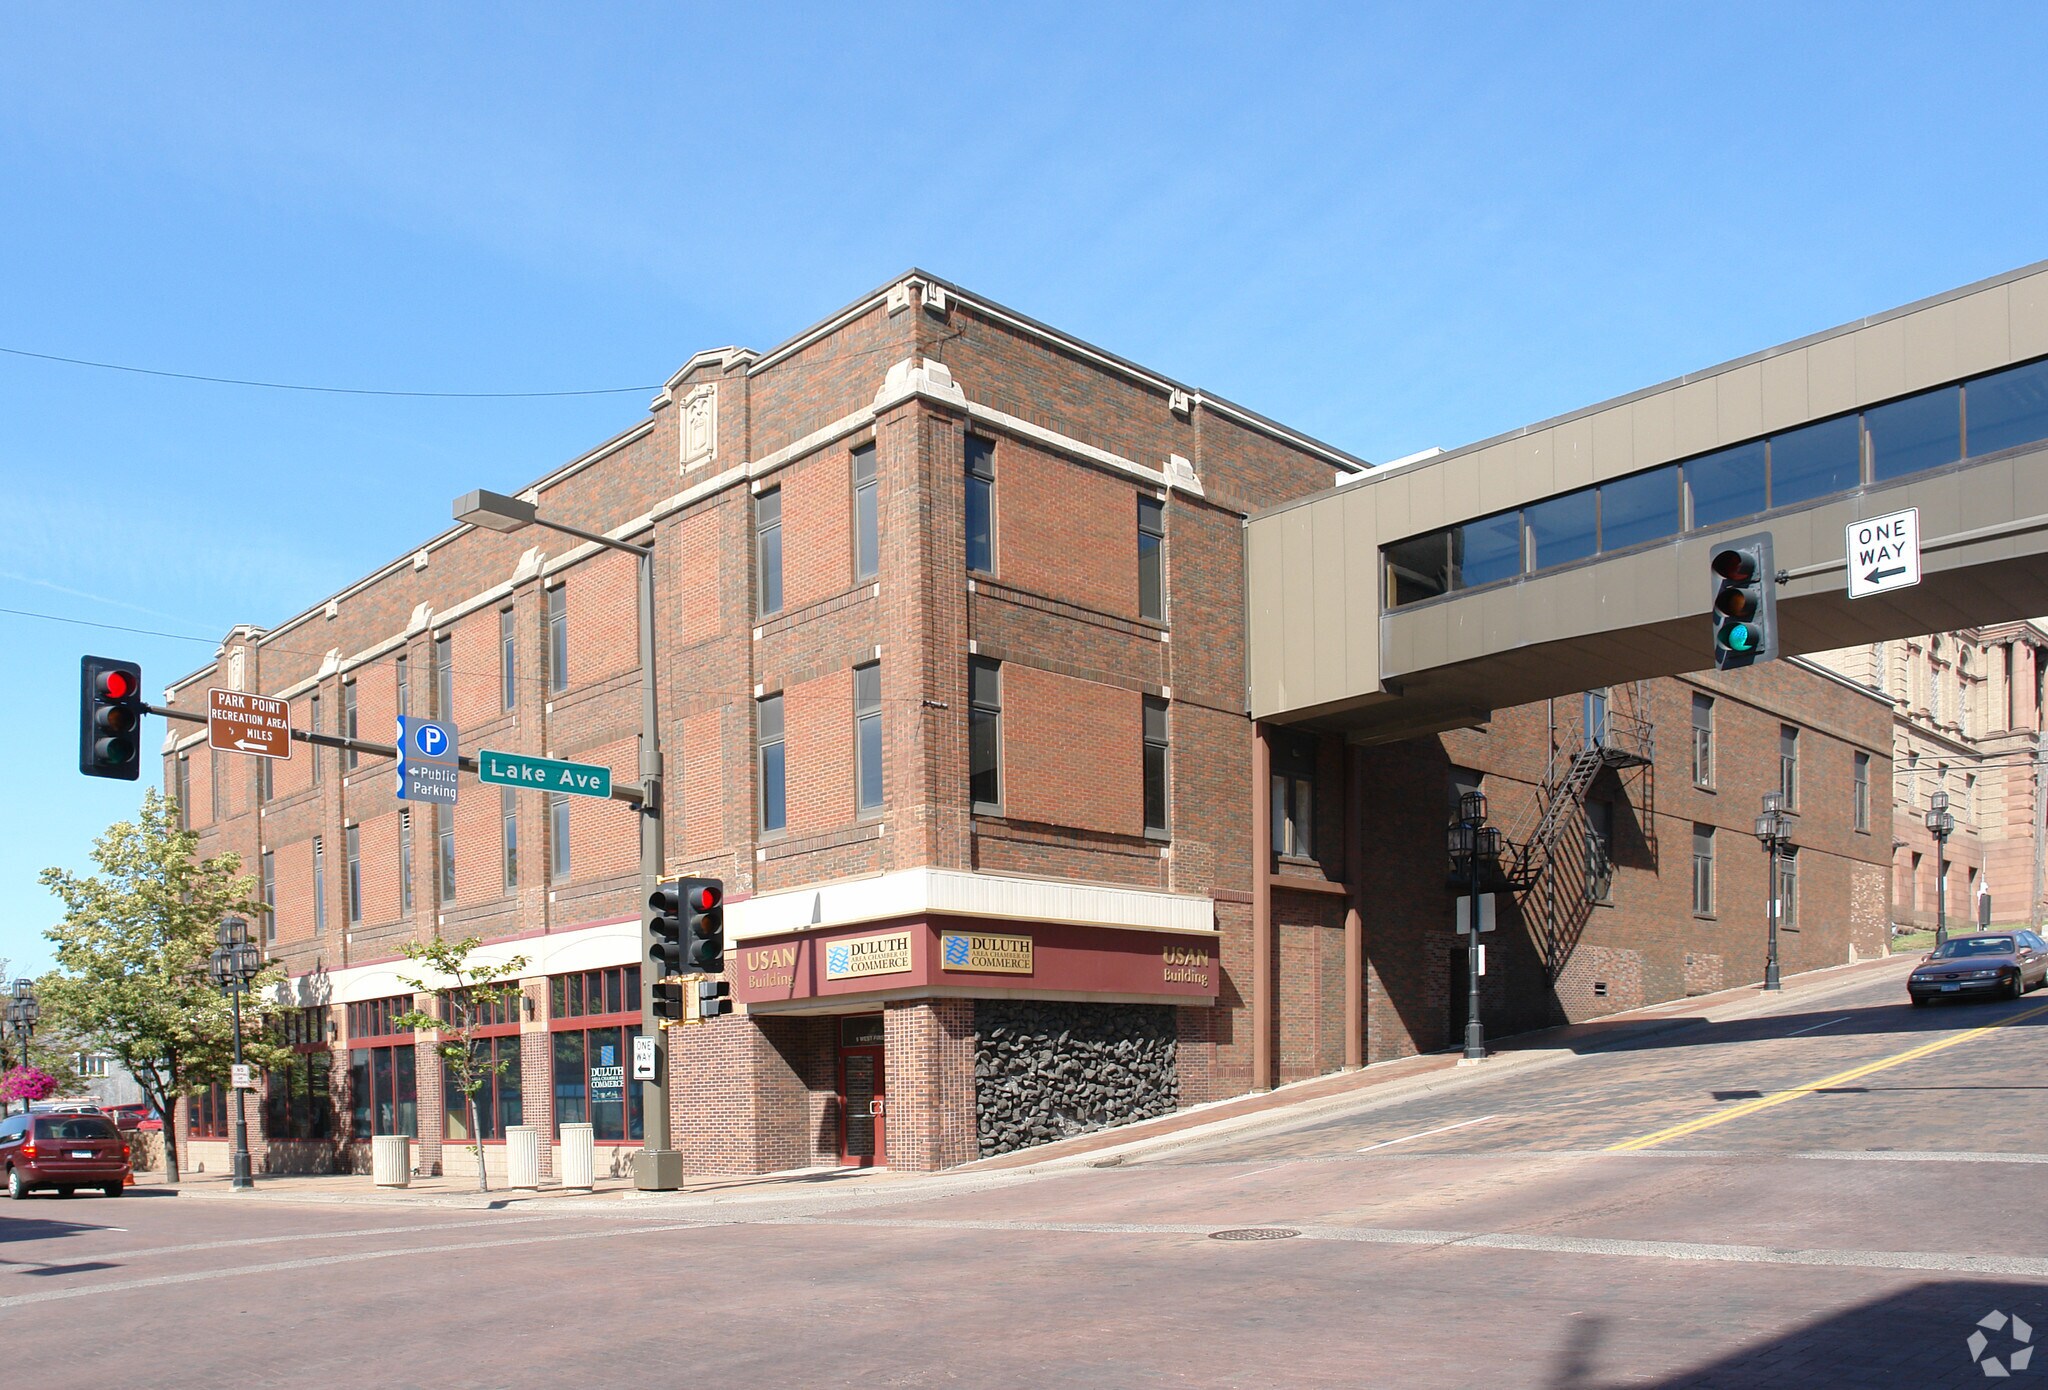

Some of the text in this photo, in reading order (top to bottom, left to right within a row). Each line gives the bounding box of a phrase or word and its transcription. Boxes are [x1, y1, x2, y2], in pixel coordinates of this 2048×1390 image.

[1859, 520, 1906, 545] ONE
[1859, 541, 1906, 566] WAY
[218, 693, 281, 714] PARK POINT
[211, 708, 288, 730] RECREATION AREA
[247, 728, 273, 741] MILES
[426, 727, 441, 753] P
[421, 767, 457, 782] Public
[491, 759, 601, 789] Lake Ave
[413, 781, 457, 802] Parking
[851, 937, 908, 956] DULUTH
[971, 937, 1031, 953] DULUTH
[746, 947, 796, 971] USAN
[851, 954, 867, 962] AREA
[867, 951, 898, 960] CHAMBER
[971, 957, 1031, 969] COMMERCE
[990, 951, 1021, 959] CHAMBER
[1162, 945, 1209, 966] USAN
[850, 957, 909, 973] COMMERCE
[748, 973, 795, 989] Building
[1164, 968, 1208, 988] Building
[636, 1040, 652, 1050] ONE
[636, 1053, 652, 1061] WAY
[591, 1066, 624, 1077] DULUTH
[591, 1080, 624, 1088] COMMERCE
